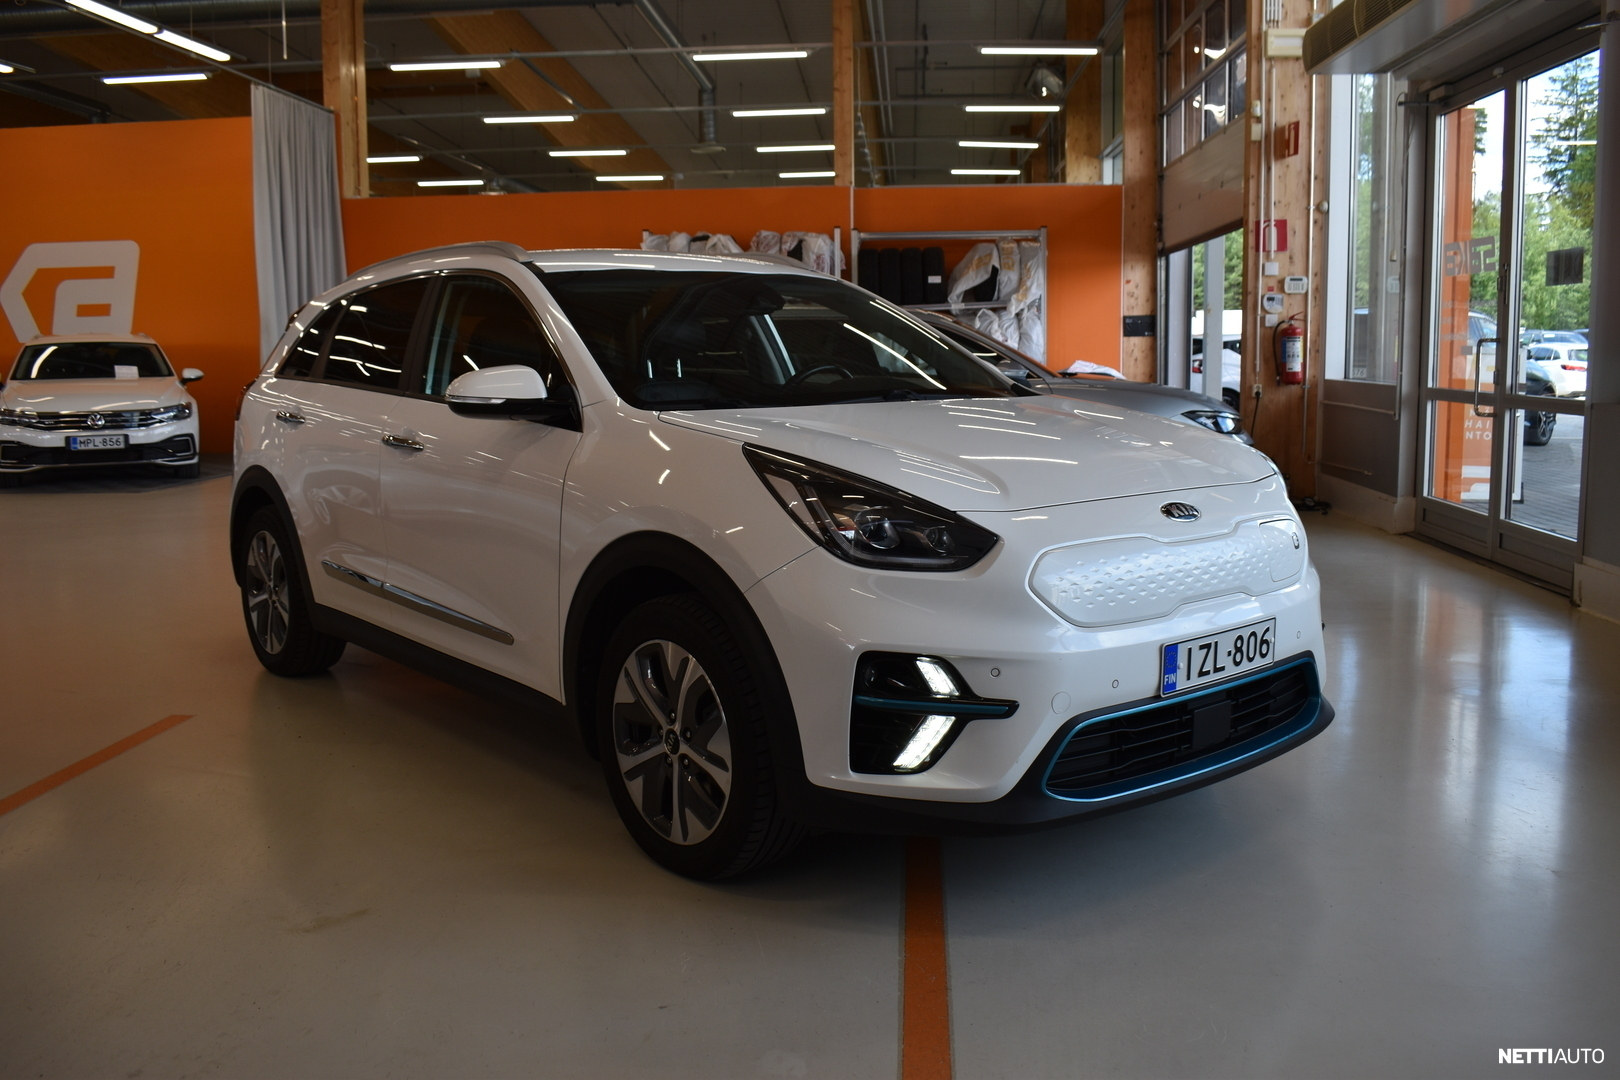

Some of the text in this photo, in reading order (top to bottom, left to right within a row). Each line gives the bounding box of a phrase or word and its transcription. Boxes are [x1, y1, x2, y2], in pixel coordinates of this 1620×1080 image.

[79, 437, 122, 448] MPL-856
[1169, 503, 1199, 518] KIA
[1186, 626, 1271, 681] IZL-806
[1164, 673, 1177, 686] FIN
